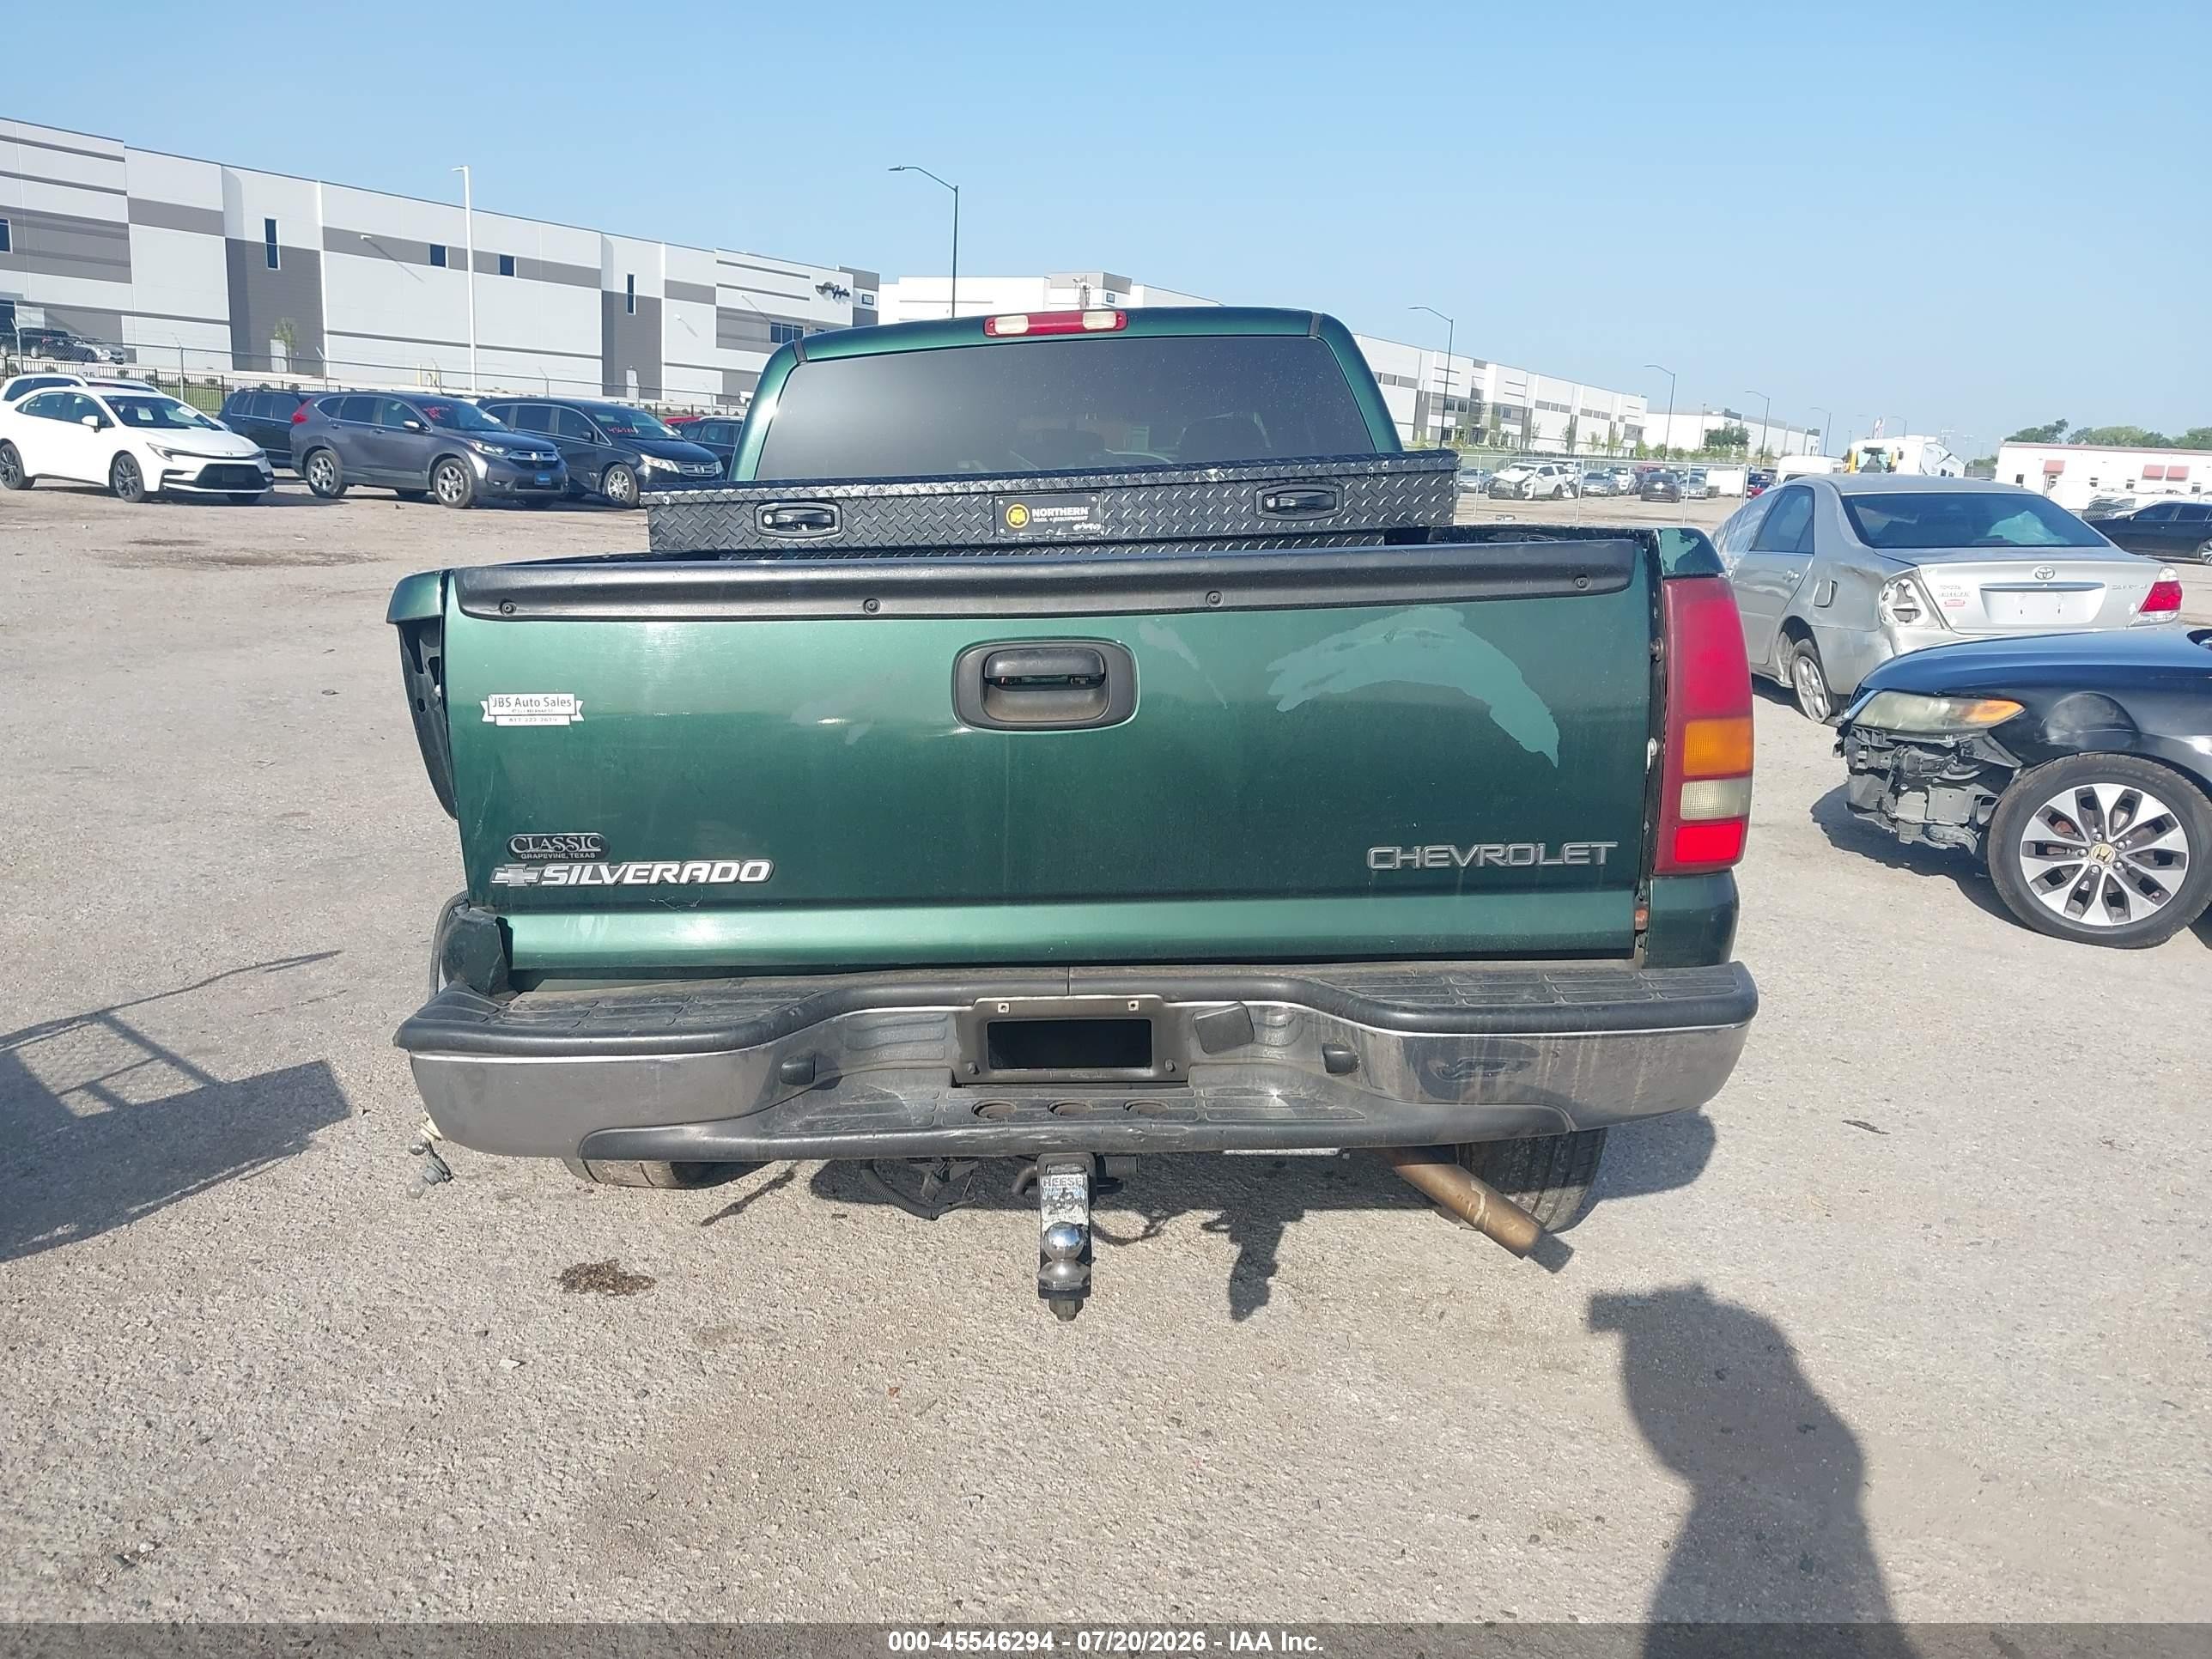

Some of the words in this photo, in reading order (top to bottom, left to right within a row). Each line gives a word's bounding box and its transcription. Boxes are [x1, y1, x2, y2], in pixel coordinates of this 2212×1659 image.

[1031, 507, 1089, 517] NORTHERN
[492, 696, 511, 708] JBS
[514, 696, 541, 708] Auto
[543, 696, 572, 708] Sales
[510, 835, 601, 854] CLASSIC
[1367, 842, 1619, 871] CHEVROLET
[540, 860, 773, 885] SILVERADO
